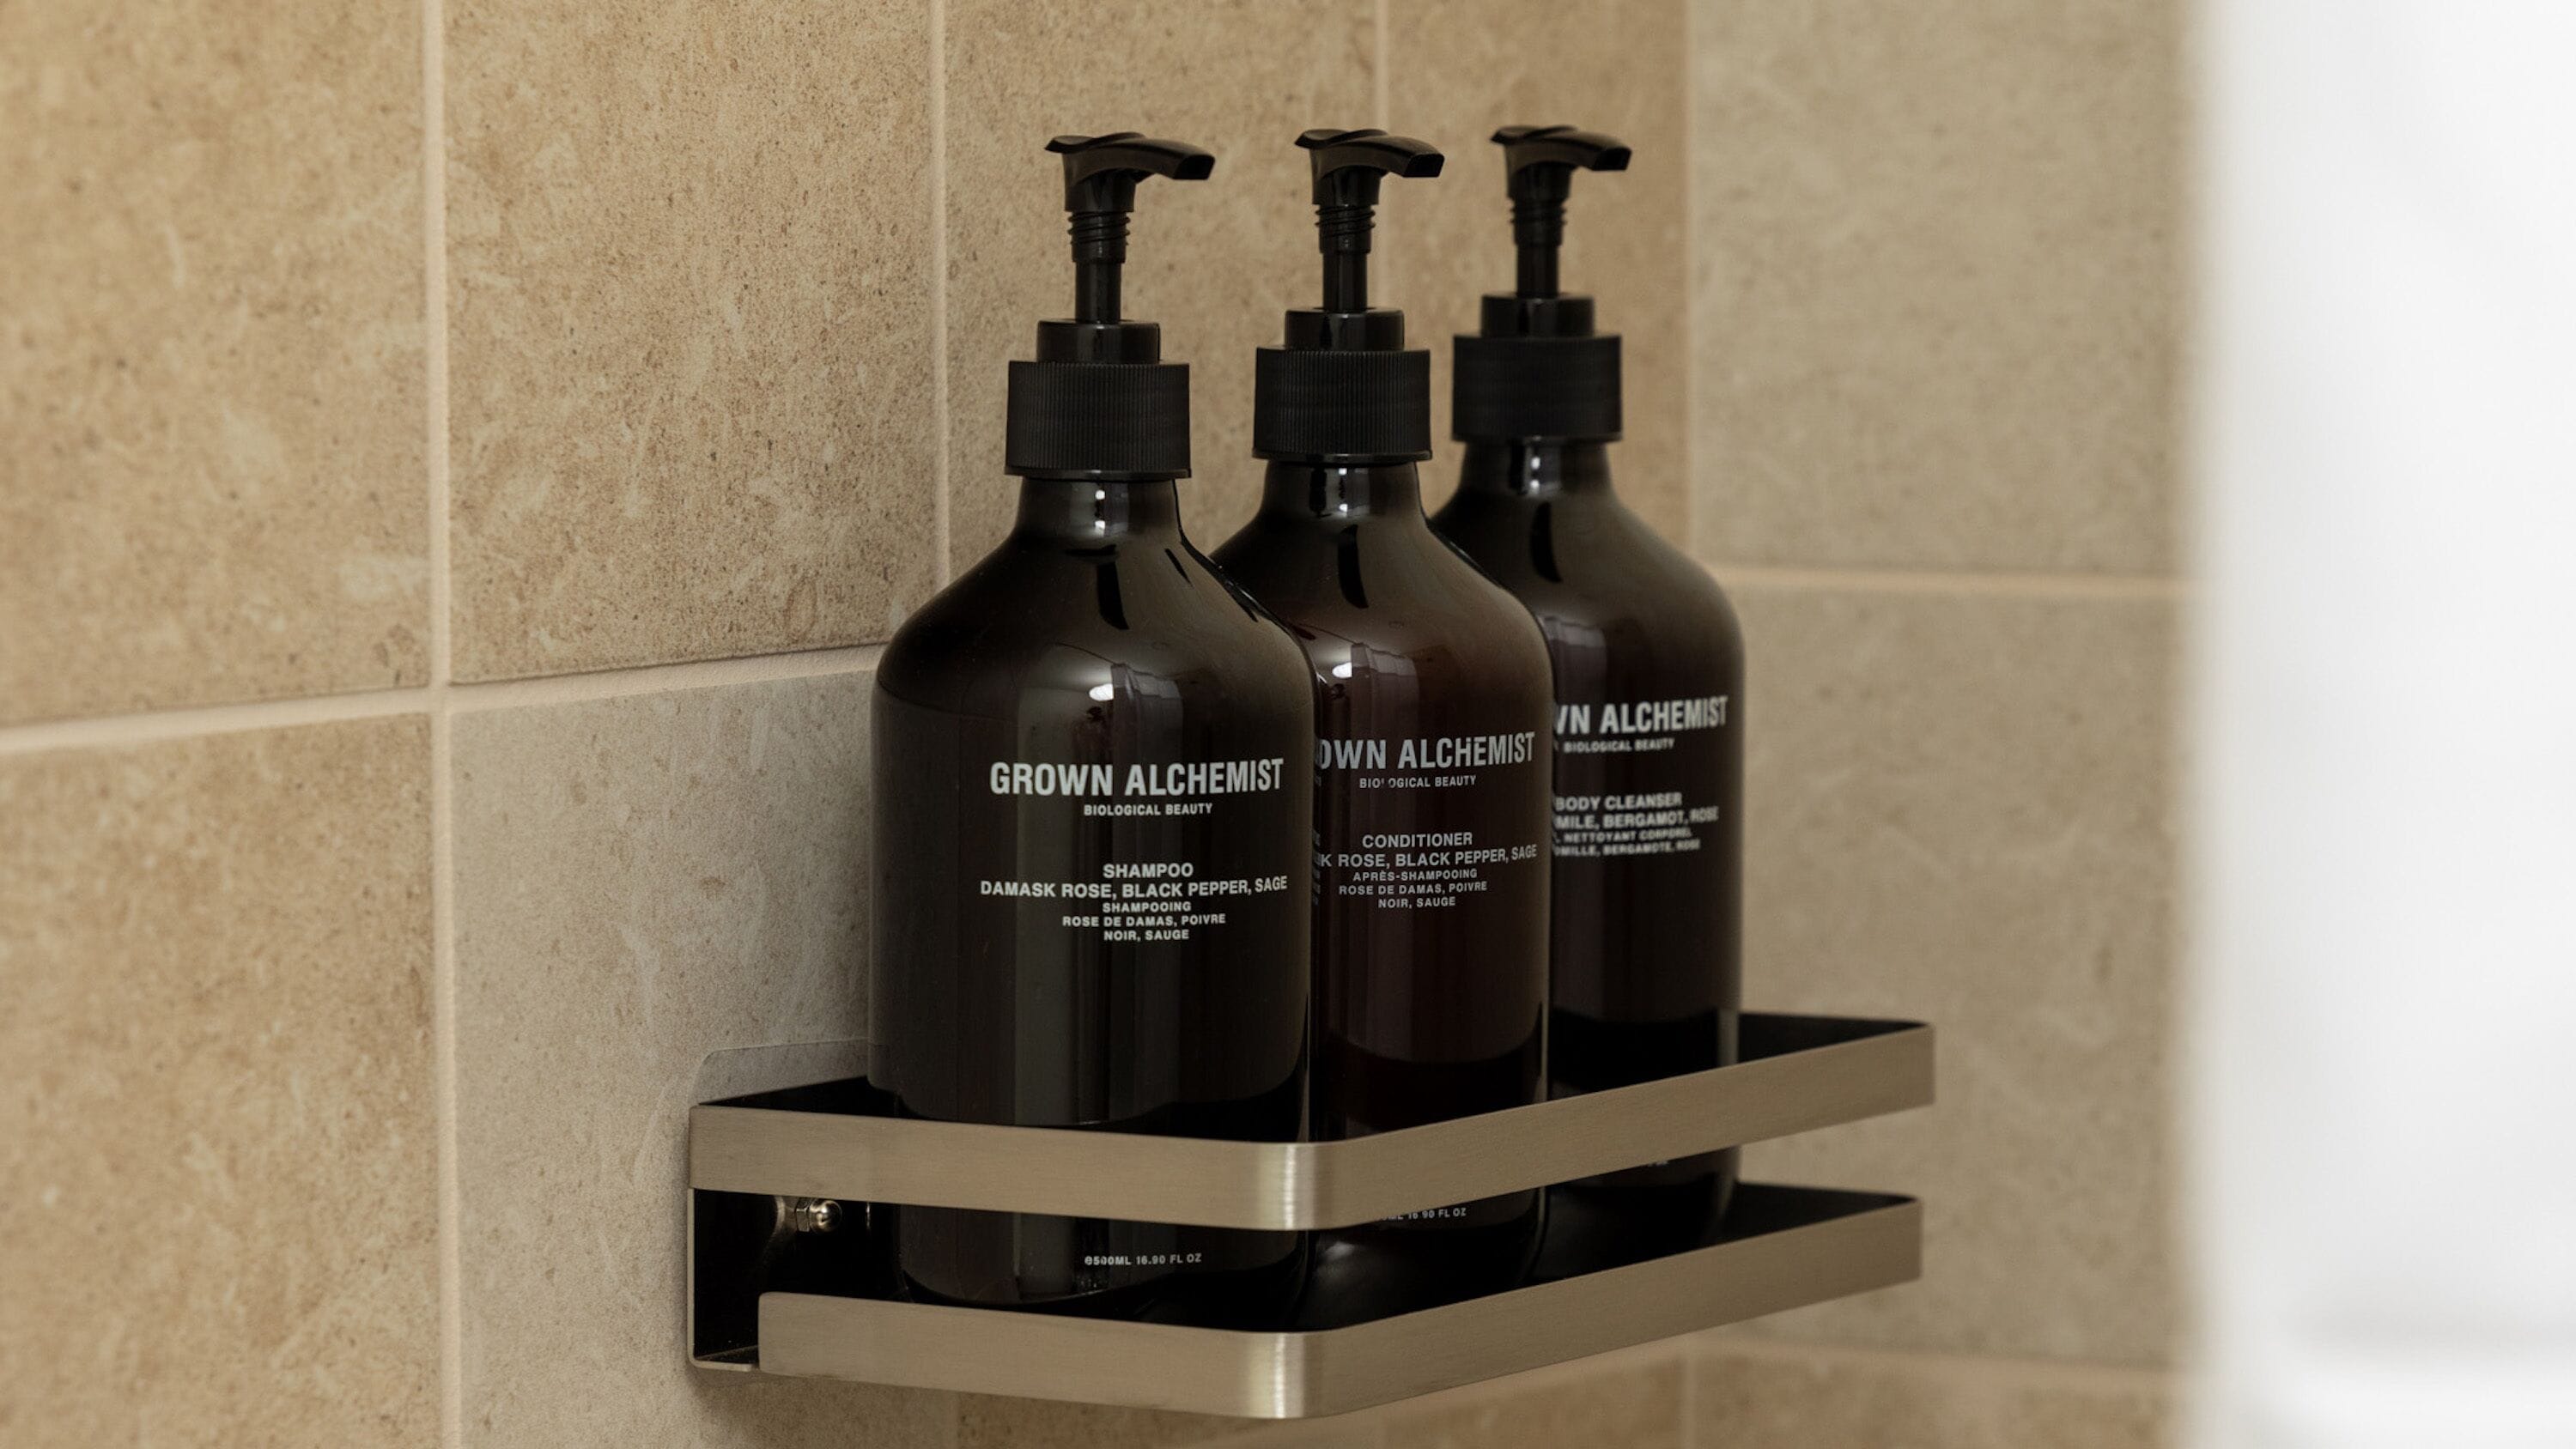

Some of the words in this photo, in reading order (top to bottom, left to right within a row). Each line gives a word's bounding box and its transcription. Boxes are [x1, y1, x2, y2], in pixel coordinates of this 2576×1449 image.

[1599, 694, 1728, 734] ALCHEMIST
[1397, 731, 1535, 770] ALCHEMIST
[1564, 740, 1632, 753] BIOLOGICAL
[1634, 737, 1674, 751] BEAUTY
[990, 761, 1114, 797] GROWN
[1124, 757, 1284, 796] ALCHEMIST
[1435, 774, 1477, 787] BEAUTY
[1555, 796, 1601, 810] BODY
[1604, 791, 1682, 810] CLEANSER
[1084, 803, 1161, 816] BIOLOGICAL
[1165, 803, 1212, 815] BEAUTY
[1602, 809, 1688, 829] BERGAMOT,
[1362, 832, 1473, 849] CONDITIONER
[1564, 830, 1636, 843] NETTOYANT
[1338, 854, 1390, 870] ROSE,
[1395, 852, 1450, 868] BLACK
[1455, 848, 1509, 865] PEPPER,
[1511, 844, 1537, 860] SAGE
[1103, 862, 1194, 880] SHAMPOO
[1352, 869, 1478, 882] APRÈS-SHAMPOOING
[980, 880, 1055, 898] DAMASK
[1061, 882, 1117, 900] ROSE,
[1122, 882, 1182, 899] BLACK
[1188, 879, 1252, 897] PEPPER,
[1255, 875, 1288, 893] SAGE
[1339, 885, 1374, 895] ROSE
[1378, 884, 1394, 894] DE
[1399, 883, 1445, 894] DAMAS,
[1449, 881, 1487, 893] POIVRE
[1102, 900, 1192, 913] SHAMPOOING
[1377, 899, 1413, 909] NOIR,
[1416, 896, 1456, 907] SAUGE
[1062, 915, 1100, 928] ROSE
[1103, 916, 1121, 928] DE
[1126, 915, 1177, 928] DAMAS,
[1181, 912, 1226, 926] POIVRE
[1103, 930, 1141, 943] NOIR,
[1145, 929, 1189, 941] SAUGE
[1438, 1209, 1451, 1217] FL
[1453, 1208, 1467, 1216] OZ
[1136, 1255, 1166, 1265] 16.90
[1170, 1253, 1183, 1264] FL
[1187, 1252, 1202, 1263] OZ
